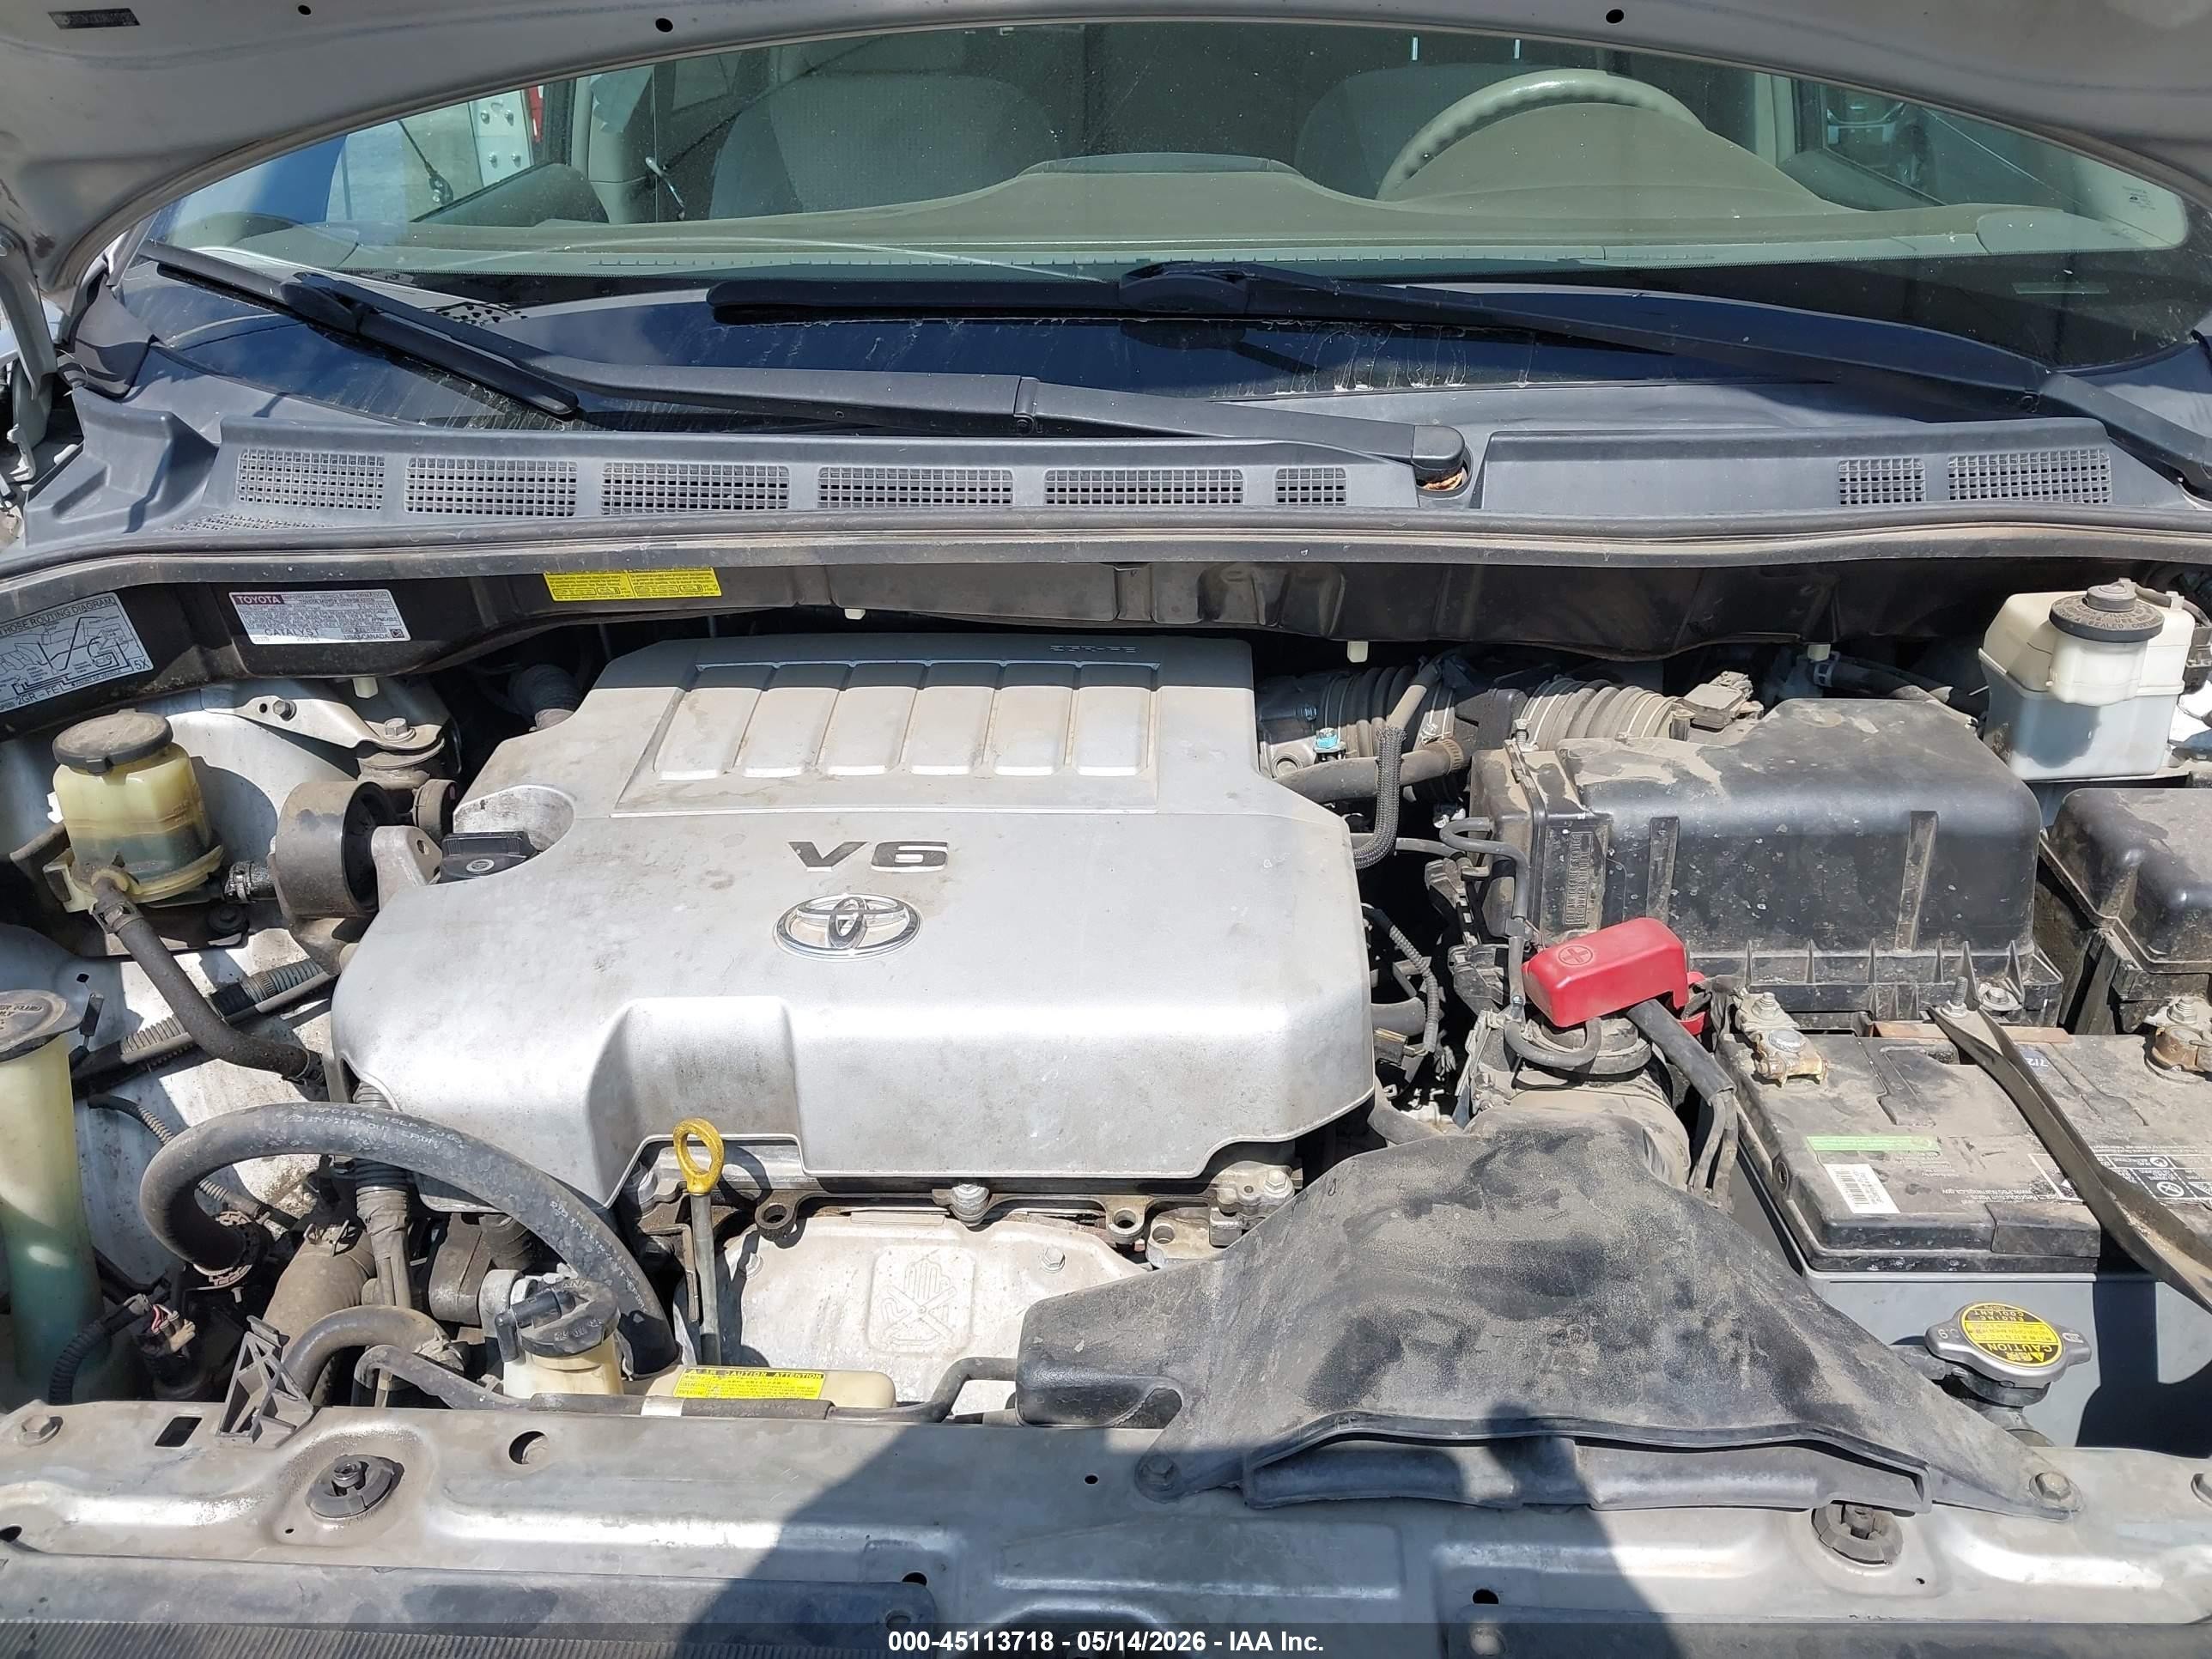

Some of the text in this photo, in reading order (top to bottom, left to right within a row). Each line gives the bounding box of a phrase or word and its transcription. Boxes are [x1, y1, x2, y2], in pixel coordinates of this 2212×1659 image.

[236, 595, 282, 605] TOYOTA
[3, 623, 29, 635] HOSE
[30, 608, 70, 626] ROUTING
[72, 598, 115, 613] DIAGRAM
[264, 628, 319, 636] CATALYST
[134, 659, 150, 670] 5X
[46, 684, 60, 696] FE
[787, 840, 949, 872] V6
[1987, 1343, 2052, 1353] CAUTION
